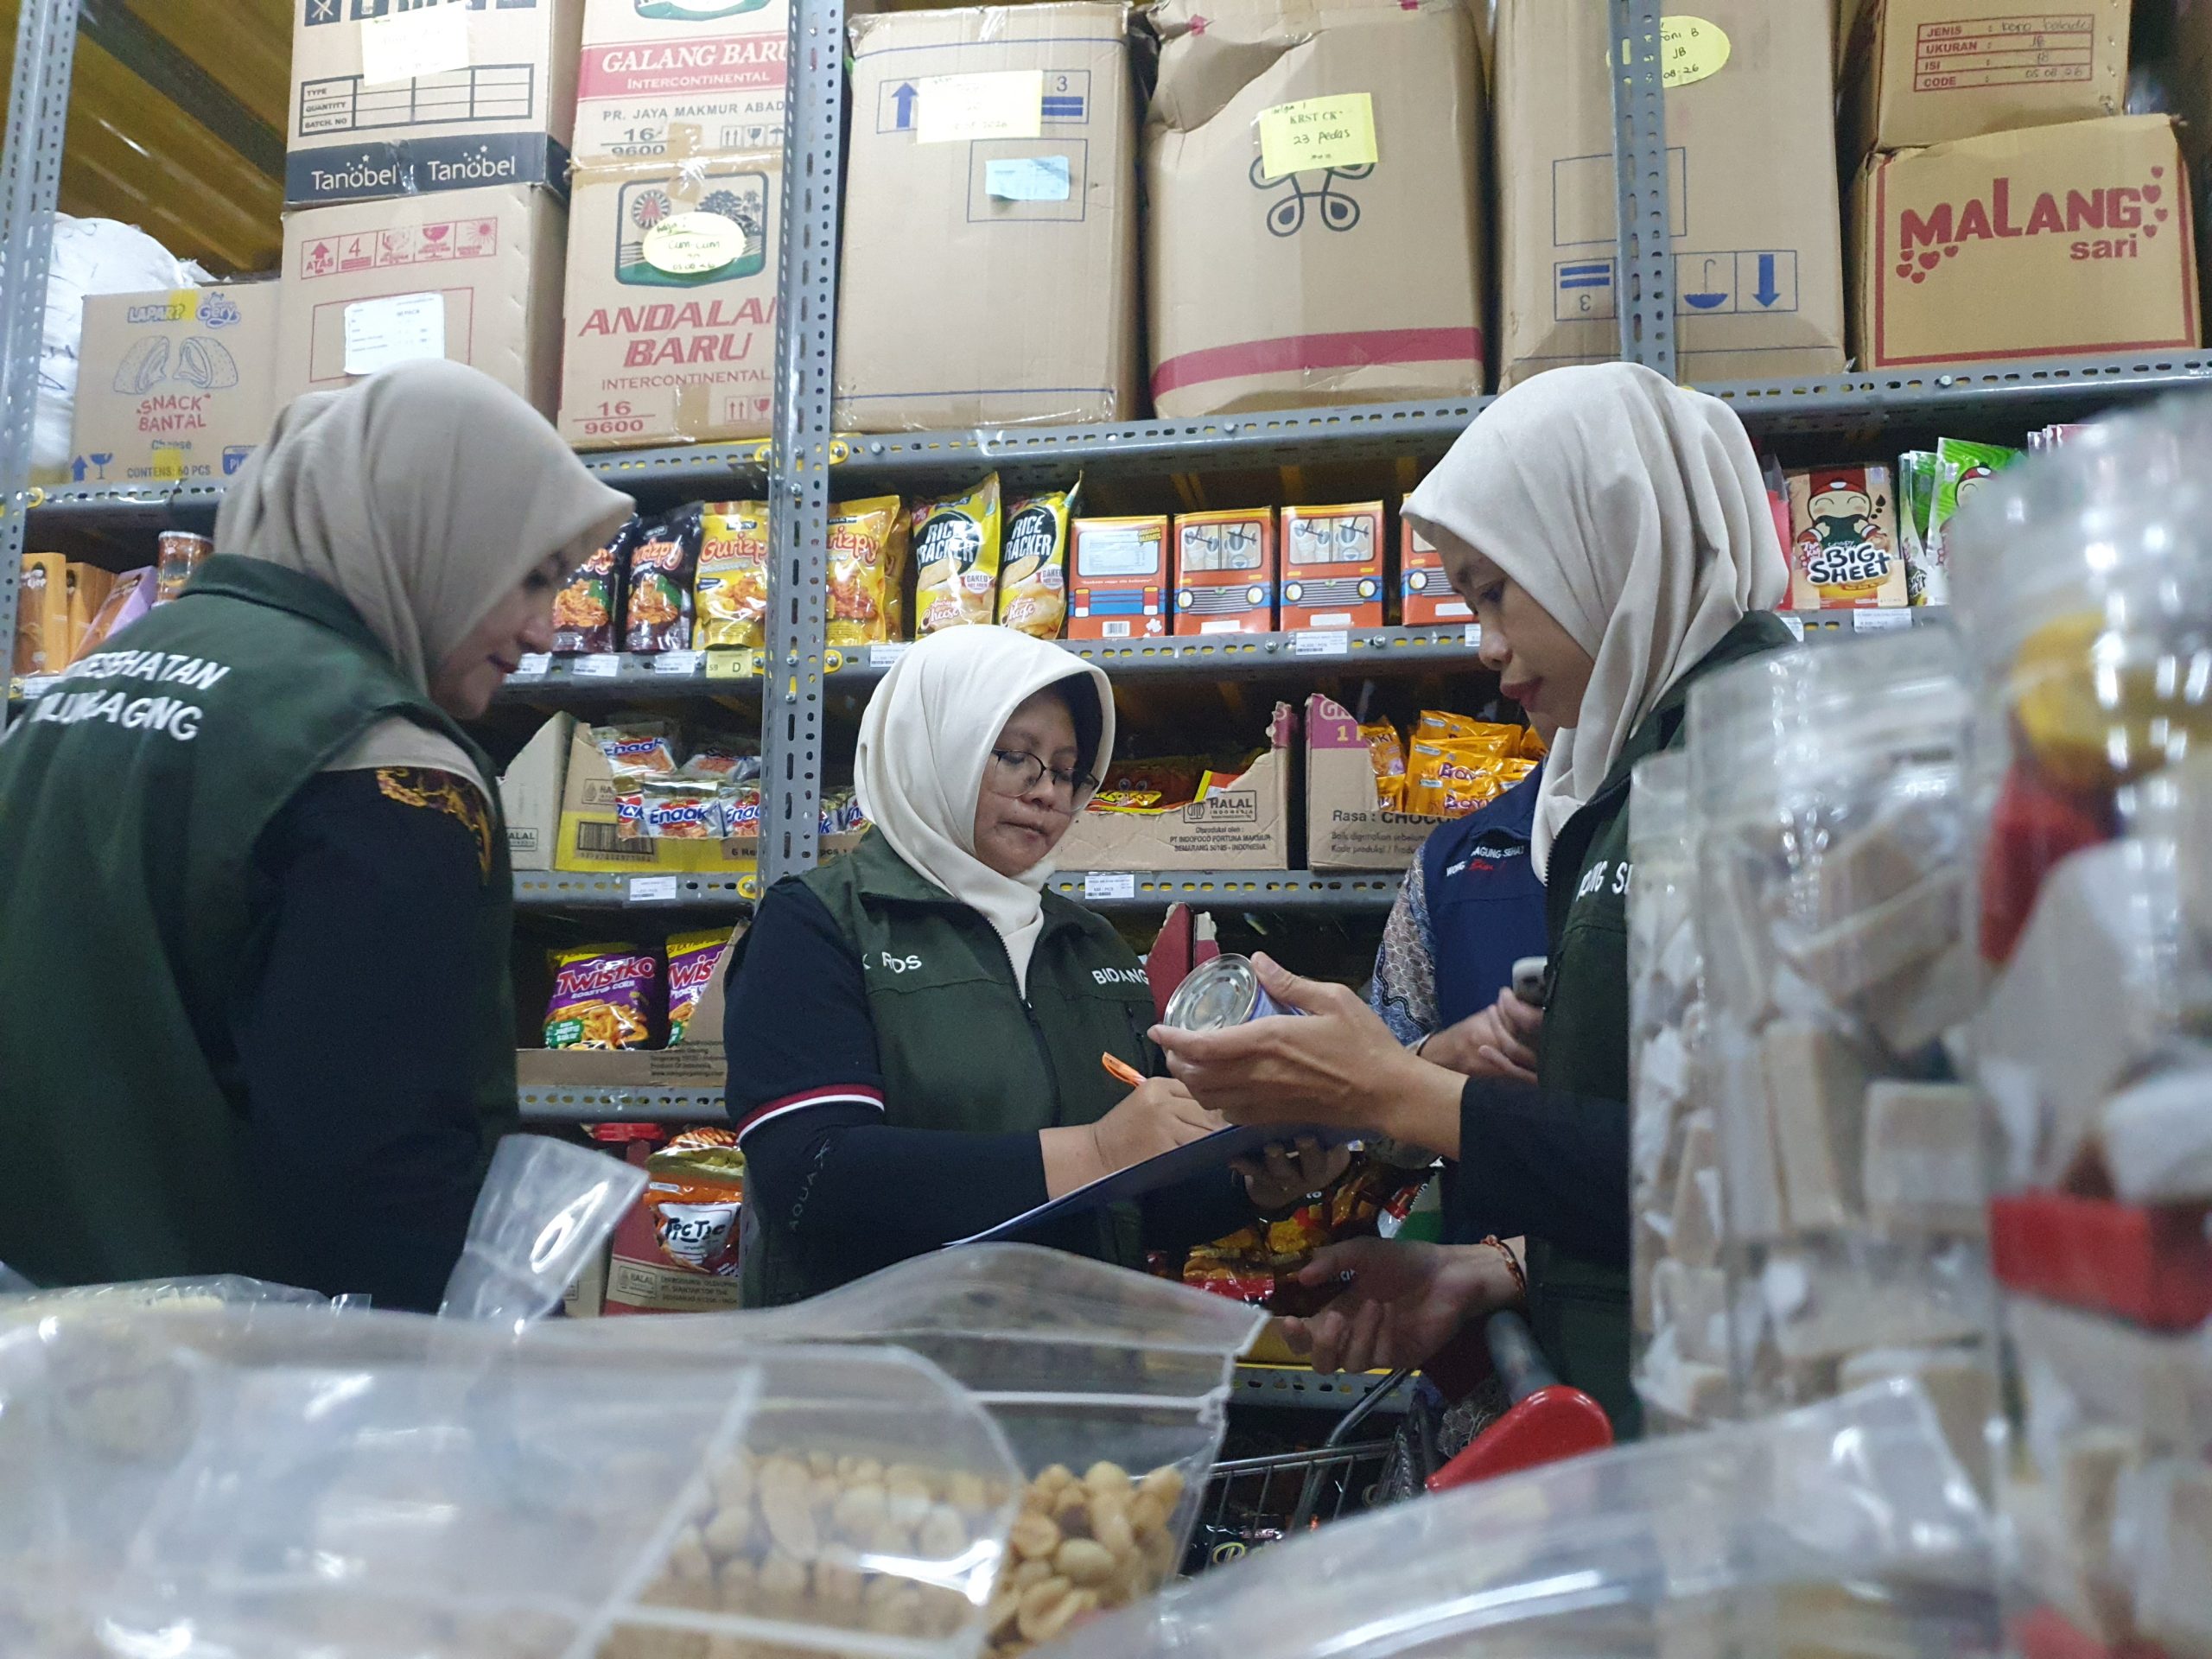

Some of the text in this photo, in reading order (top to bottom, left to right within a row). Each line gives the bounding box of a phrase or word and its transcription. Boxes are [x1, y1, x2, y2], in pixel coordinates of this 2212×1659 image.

[1691, 28, 1700, 37] B
[1927, 25, 1961, 37] JENIS
[1926, 41, 1978, 54] UKURAN
[602, 44, 717, 73] GALANG
[1924, 60, 1941, 71] ISI
[627, 71, 771, 90] INTERCONTINENTAL
[1056, 75, 1068, 92] 3
[1924, 76, 1957, 87] CODE
[307, 87, 327, 96] TYPE
[305, 101, 346, 113] QUANTITY
[603, 110, 626, 121] PR.
[632, 107, 669, 119] JAYA
[675, 104, 737, 118] MAKMUR
[623, 128, 654, 142] 16
[1294, 134, 1310, 144] 23
[611, 145, 665, 157] 9600
[427, 154, 516, 181] Tanobel
[311, 162, 397, 191] Tanobel
[1901, 177, 2142, 251] MALANG
[349, 237, 360, 257] 4
[2069, 233, 2138, 260] sari
[306, 257, 334, 270] ATAS
[1580, 294, 1592, 312] 3
[623, 333, 753, 368] BARU
[602, 369, 771, 391] INTERCONTINENTAL
[140, 394, 202, 415] SNACK
[598, 401, 632, 416] 16
[138, 414, 207, 432] BANTAL
[585, 419, 643, 434] 9600
[192, 465, 211, 476] PCS
[1011, 514, 1045, 539] RICE
[1826, 543, 1876, 569] BIG
[1809, 552, 1891, 583] SHEET
[732, 662, 741, 673] D
[1211, 798, 1252, 809] HALAL
[650, 806, 708, 824] Enaak
[1333, 810, 1366, 822] Rasa
[1091, 968, 1149, 985] BIDANG
